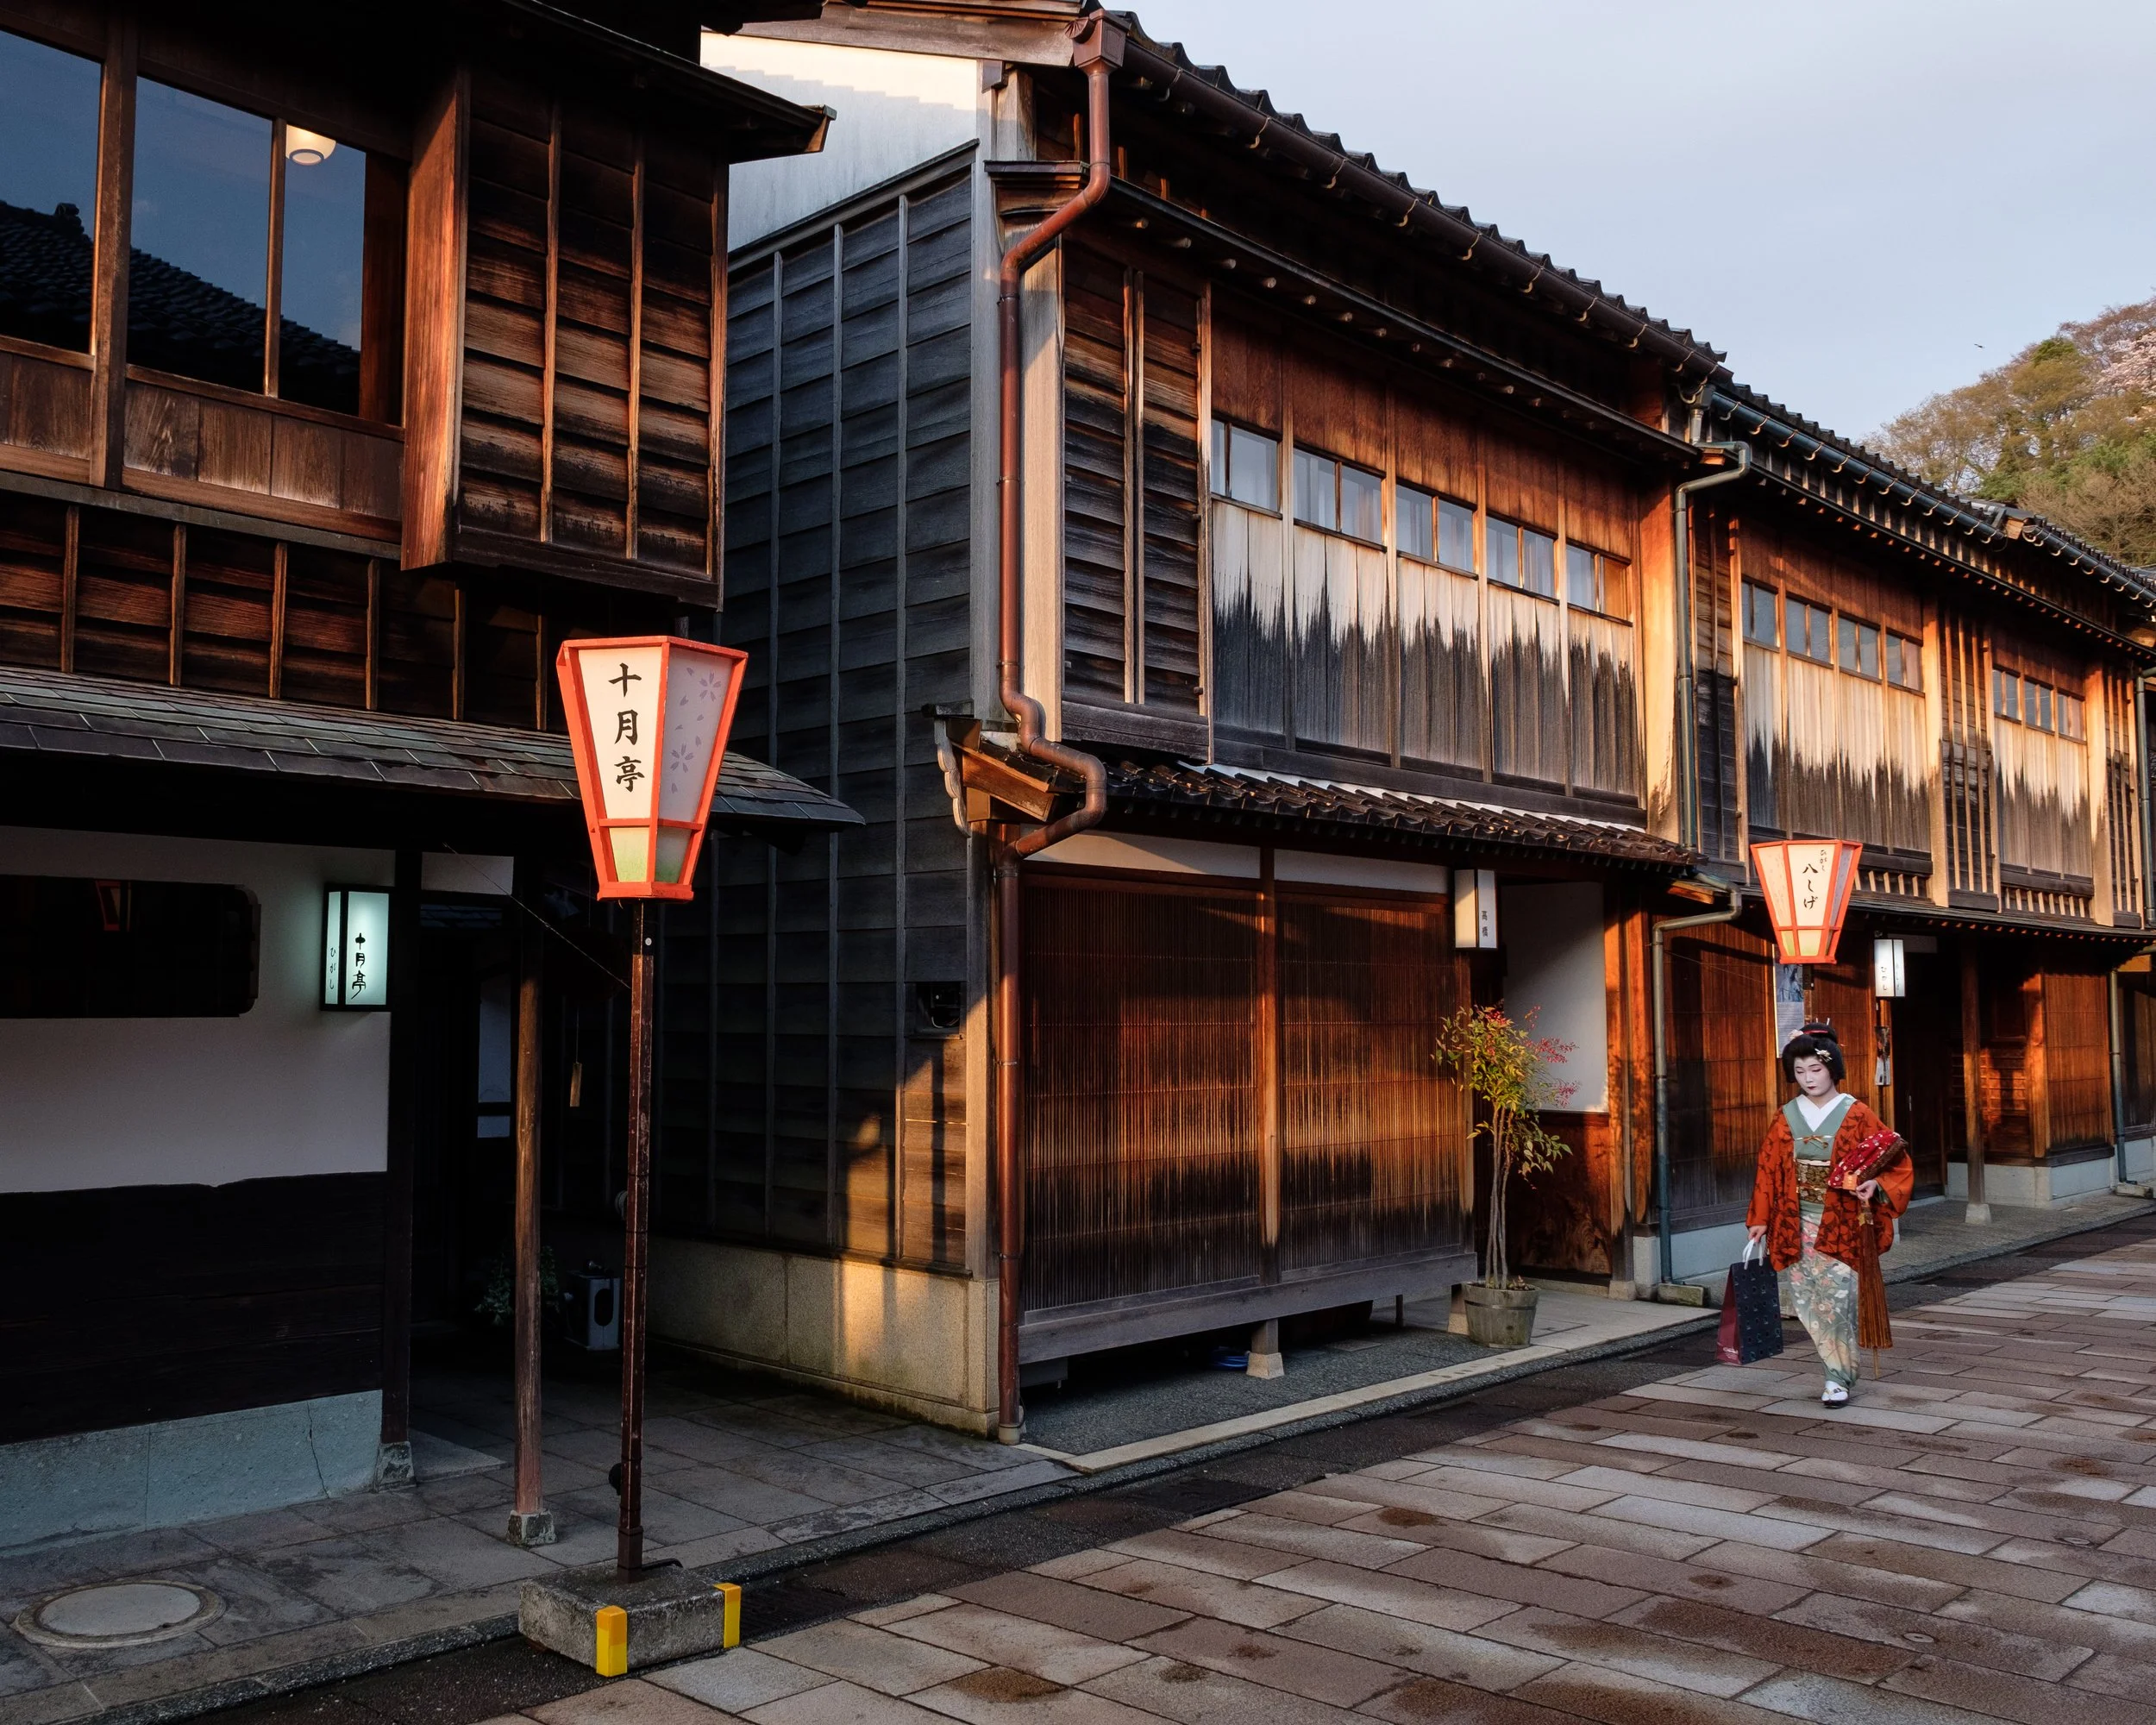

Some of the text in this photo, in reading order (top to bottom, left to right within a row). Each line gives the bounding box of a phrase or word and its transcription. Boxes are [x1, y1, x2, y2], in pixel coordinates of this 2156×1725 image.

[608, 662, 645, 793] 十月亭
[1802, 863, 1819, 910] 八しげ
[351, 932, 367, 1000] 十月亭
